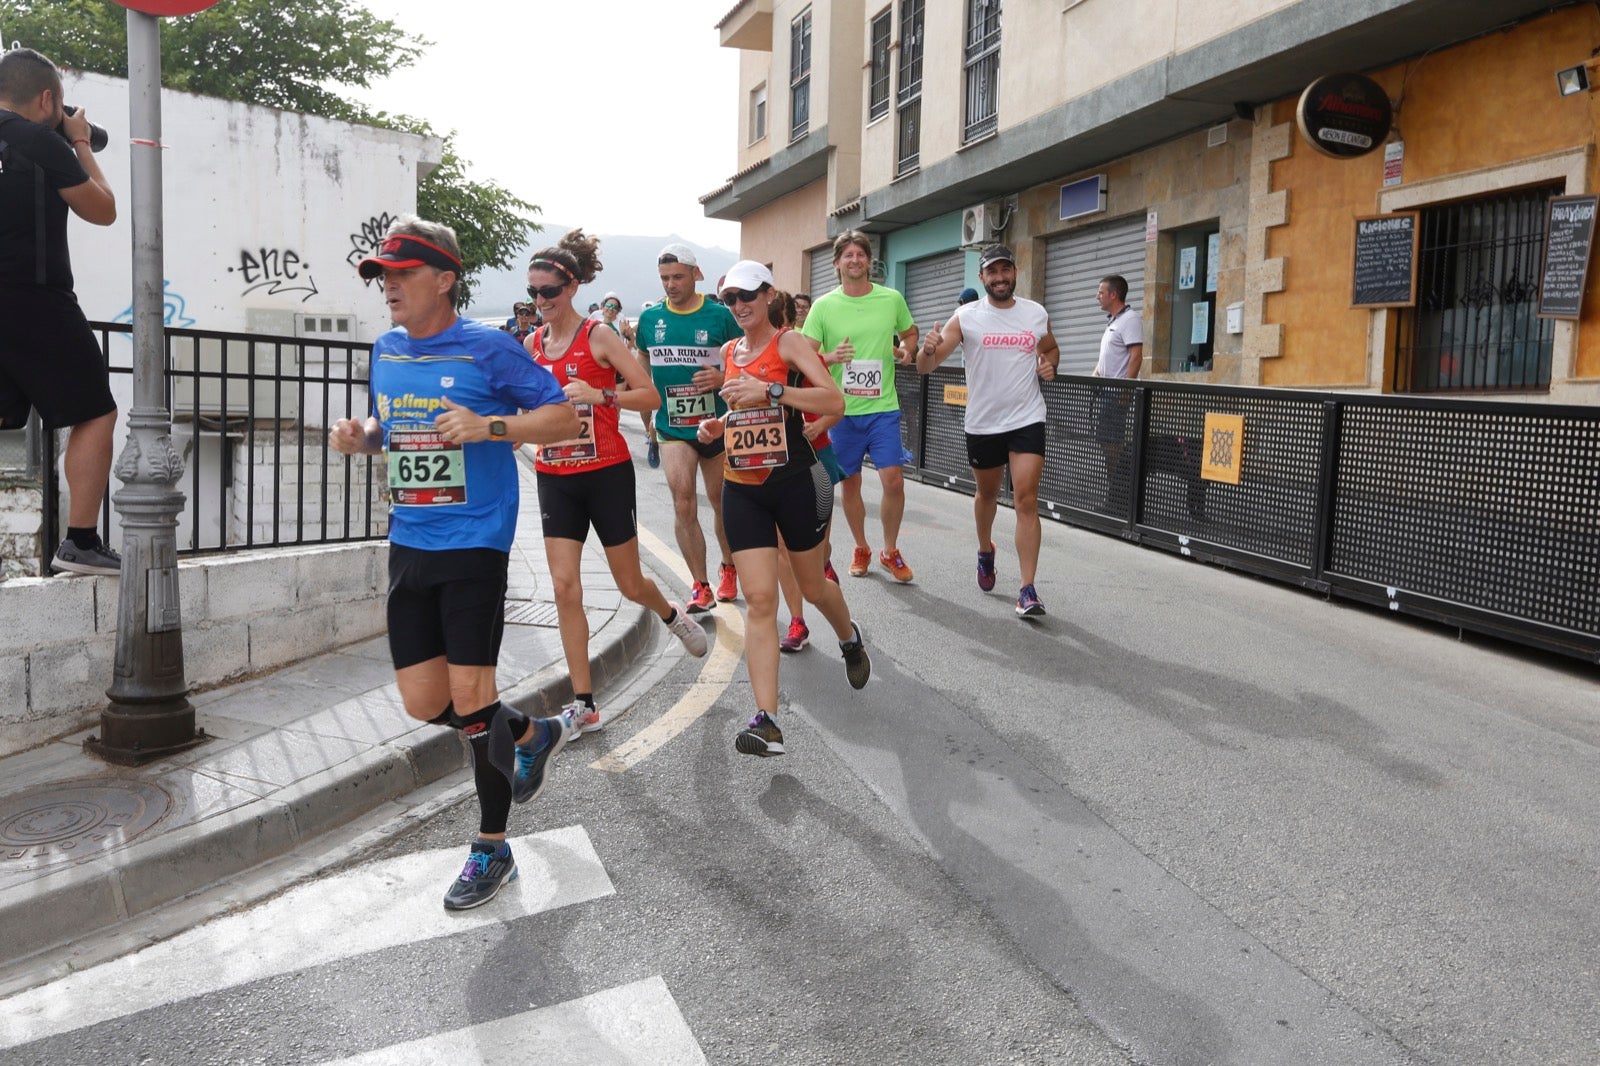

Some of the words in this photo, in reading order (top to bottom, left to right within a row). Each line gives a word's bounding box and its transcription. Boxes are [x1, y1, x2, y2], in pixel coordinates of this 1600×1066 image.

[982, 336, 1031, 346] GUADIX
[652, 348, 674, 357] CAJA
[678, 348, 710, 357] RURAL
[846, 370, 882, 388] 3080
[676, 396, 706, 414] 571
[732, 427, 782, 450] 2043
[398, 455, 452, 482] 652
